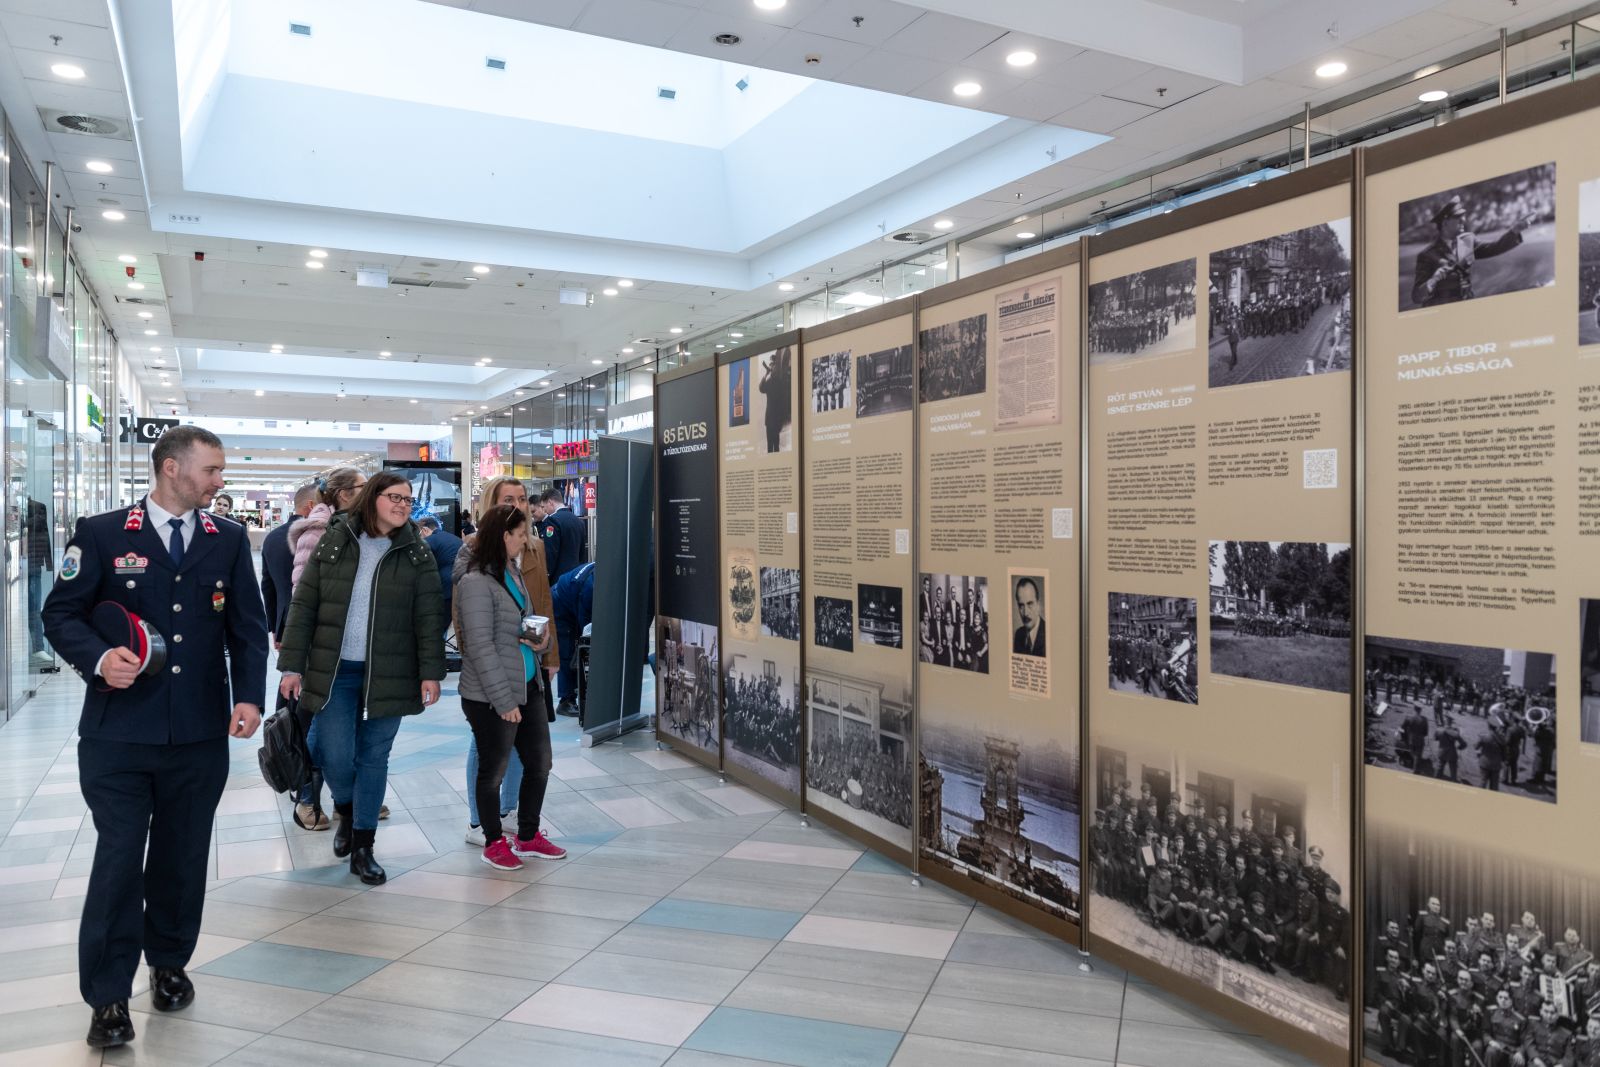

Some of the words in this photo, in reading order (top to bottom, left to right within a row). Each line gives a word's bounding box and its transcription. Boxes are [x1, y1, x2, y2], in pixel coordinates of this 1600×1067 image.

[1397, 350, 1440, 365] PAPP
[1446, 342, 1497, 358] TIBOR
[1397, 357, 1514, 381] MUNKÁSSÁGA
[1107, 392, 1126, 403] RÓT
[1129, 387, 1163, 401] ISTVÁN
[1107, 402, 1134, 415] ISMÉT
[1171, 395, 1193, 407] LÉP
[142, 423, 171, 439] C&A
[663, 428, 676, 444] 85
[677, 420, 707, 442] ÉVES
[554, 439, 590, 462] RETRO
